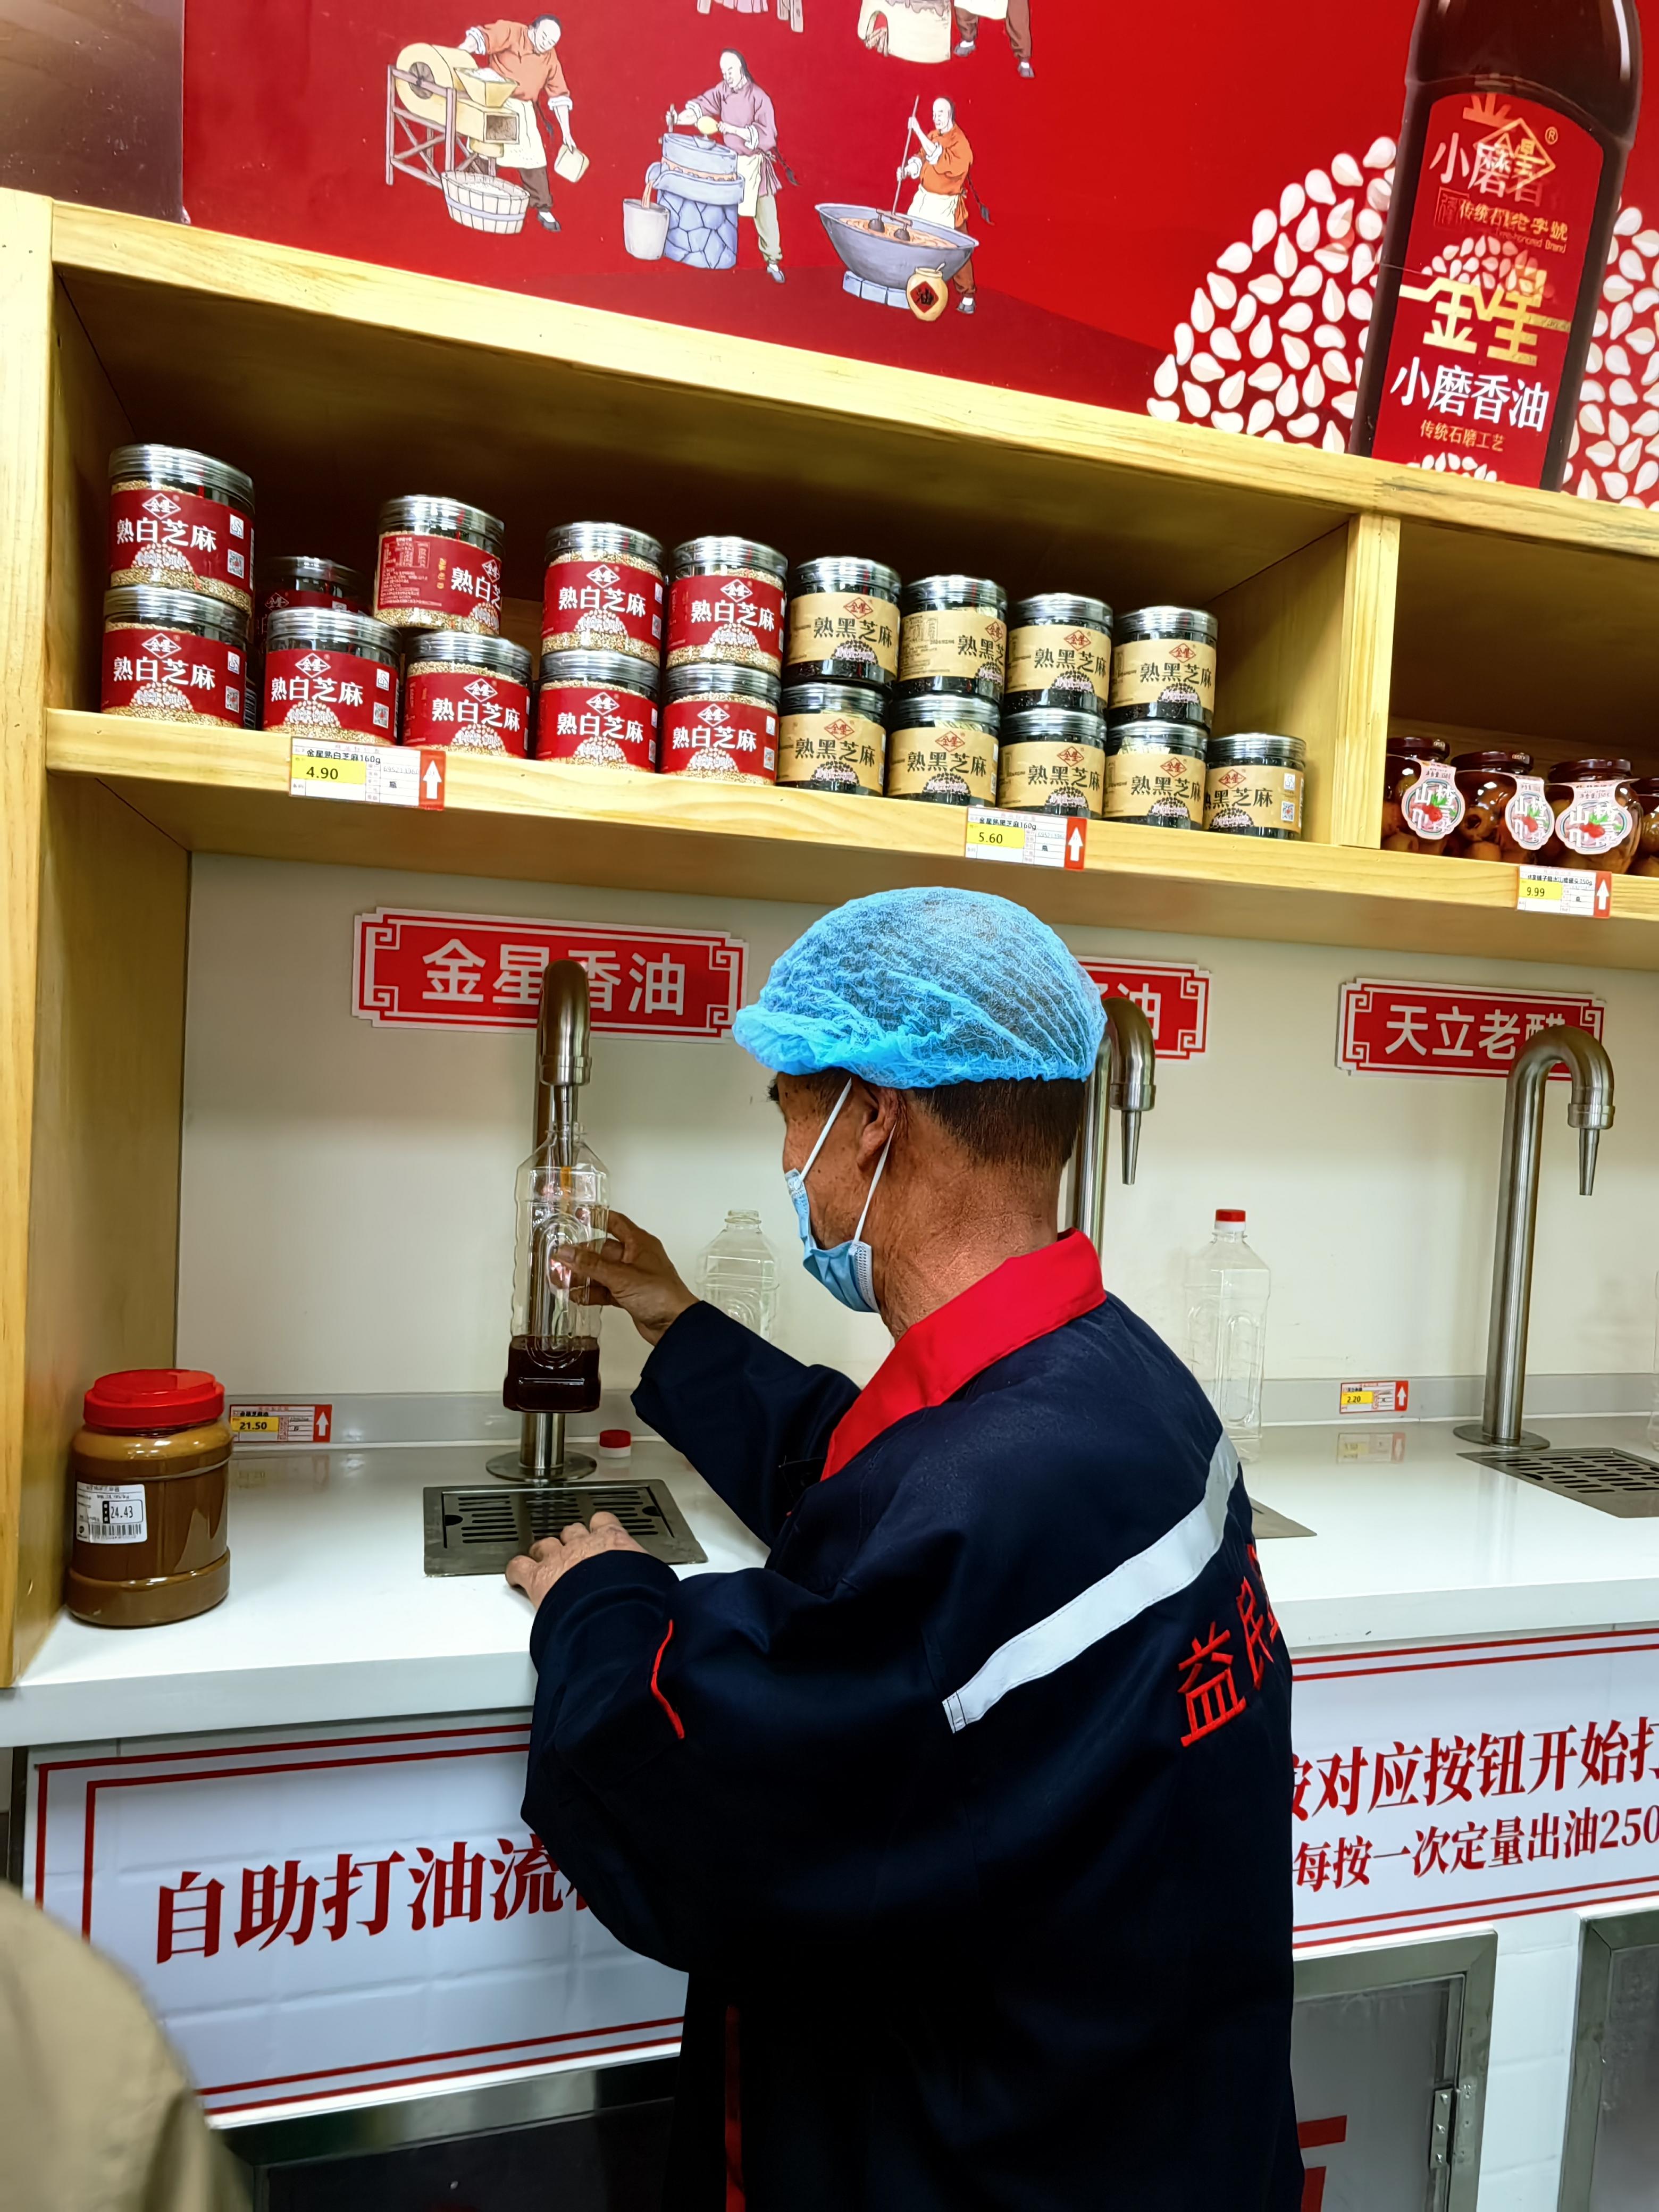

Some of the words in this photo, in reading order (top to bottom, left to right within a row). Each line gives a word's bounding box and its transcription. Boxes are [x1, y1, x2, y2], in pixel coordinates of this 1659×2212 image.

[1390, 356, 1549, 432] 小磨香油
[1420, 419, 1506, 452] 传统石磨工艺
[117, 517, 216, 552] 熟白芝麻
[559, 585, 646, 617] 熟白芝麻
[691, 599, 774, 632] 熟白芝麻
[814, 617, 892, 648] 熟黑芝麻
[114, 657, 215, 690] 熟白芝麻
[1034, 648, 1106, 678] 熟黑芝麻
[1140, 663, 1211, 689] 熟黑芝麻
[271, 676, 363, 707] 熟白芝麻
[432, 698, 520, 732] 熟白芝麻
[557, 712, 643, 743] 熟白芝麻
[673, 725, 757, 752] 熟白芝麻
[795, 738, 875, 767] 熟黑芝麻
[306, 766, 339, 780] 4.90
[907, 751, 986, 777] 熟黑芝麻
[1028, 765, 1100, 792] 熟黑芝麻
[1131, 775, 1201, 802] 熟黑芝麻
[978, 832, 1003, 844] 5.60
[1527, 887, 1545, 897] 9.99
[422, 939, 685, 1016] 金星香油
[239, 1421, 267, 1430] 21.50
[111, 1506, 133, 1519] 24.43
[155, 1832, 588, 1964] 自助打油流
